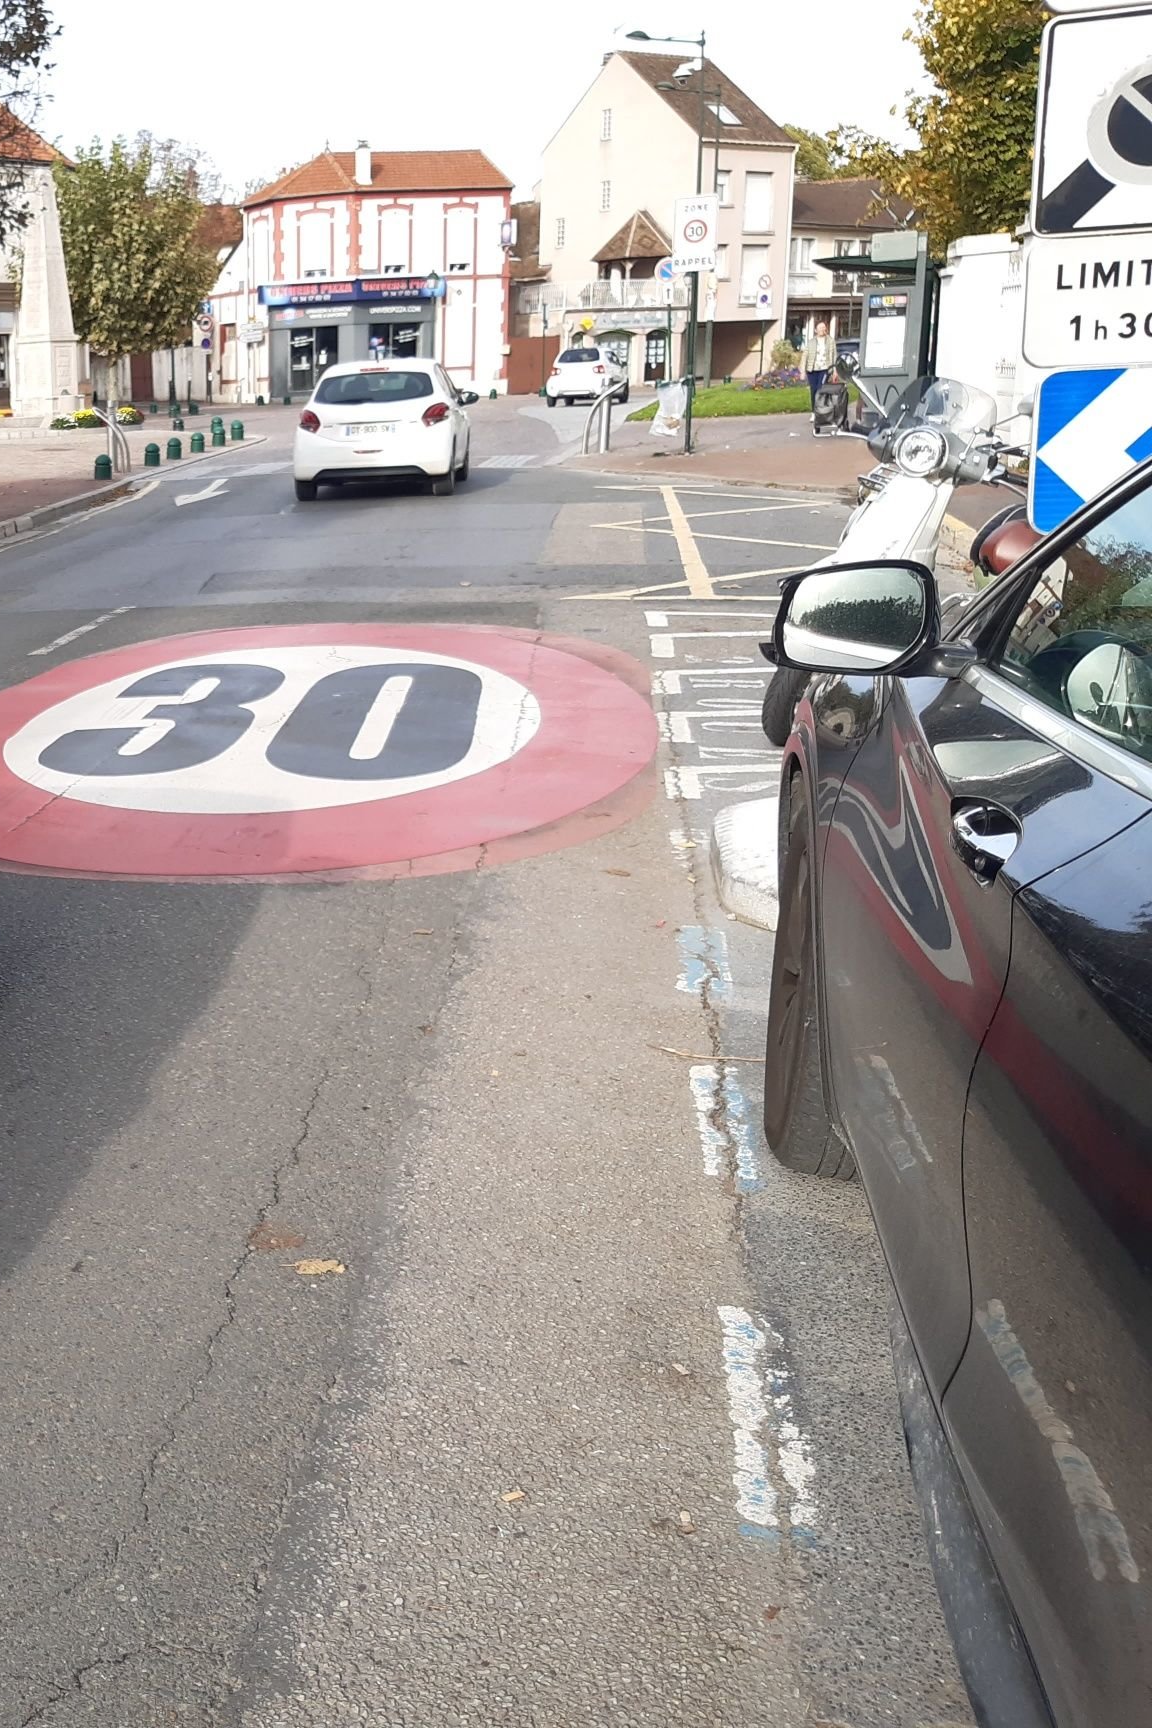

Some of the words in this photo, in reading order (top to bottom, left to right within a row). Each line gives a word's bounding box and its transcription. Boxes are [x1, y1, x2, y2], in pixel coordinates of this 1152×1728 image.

[684, 204, 709, 212] ZONE
[688, 226, 703, 237] 30
[674, 257, 713, 266] RAPPEL
[38, 663, 483, 781] 30
